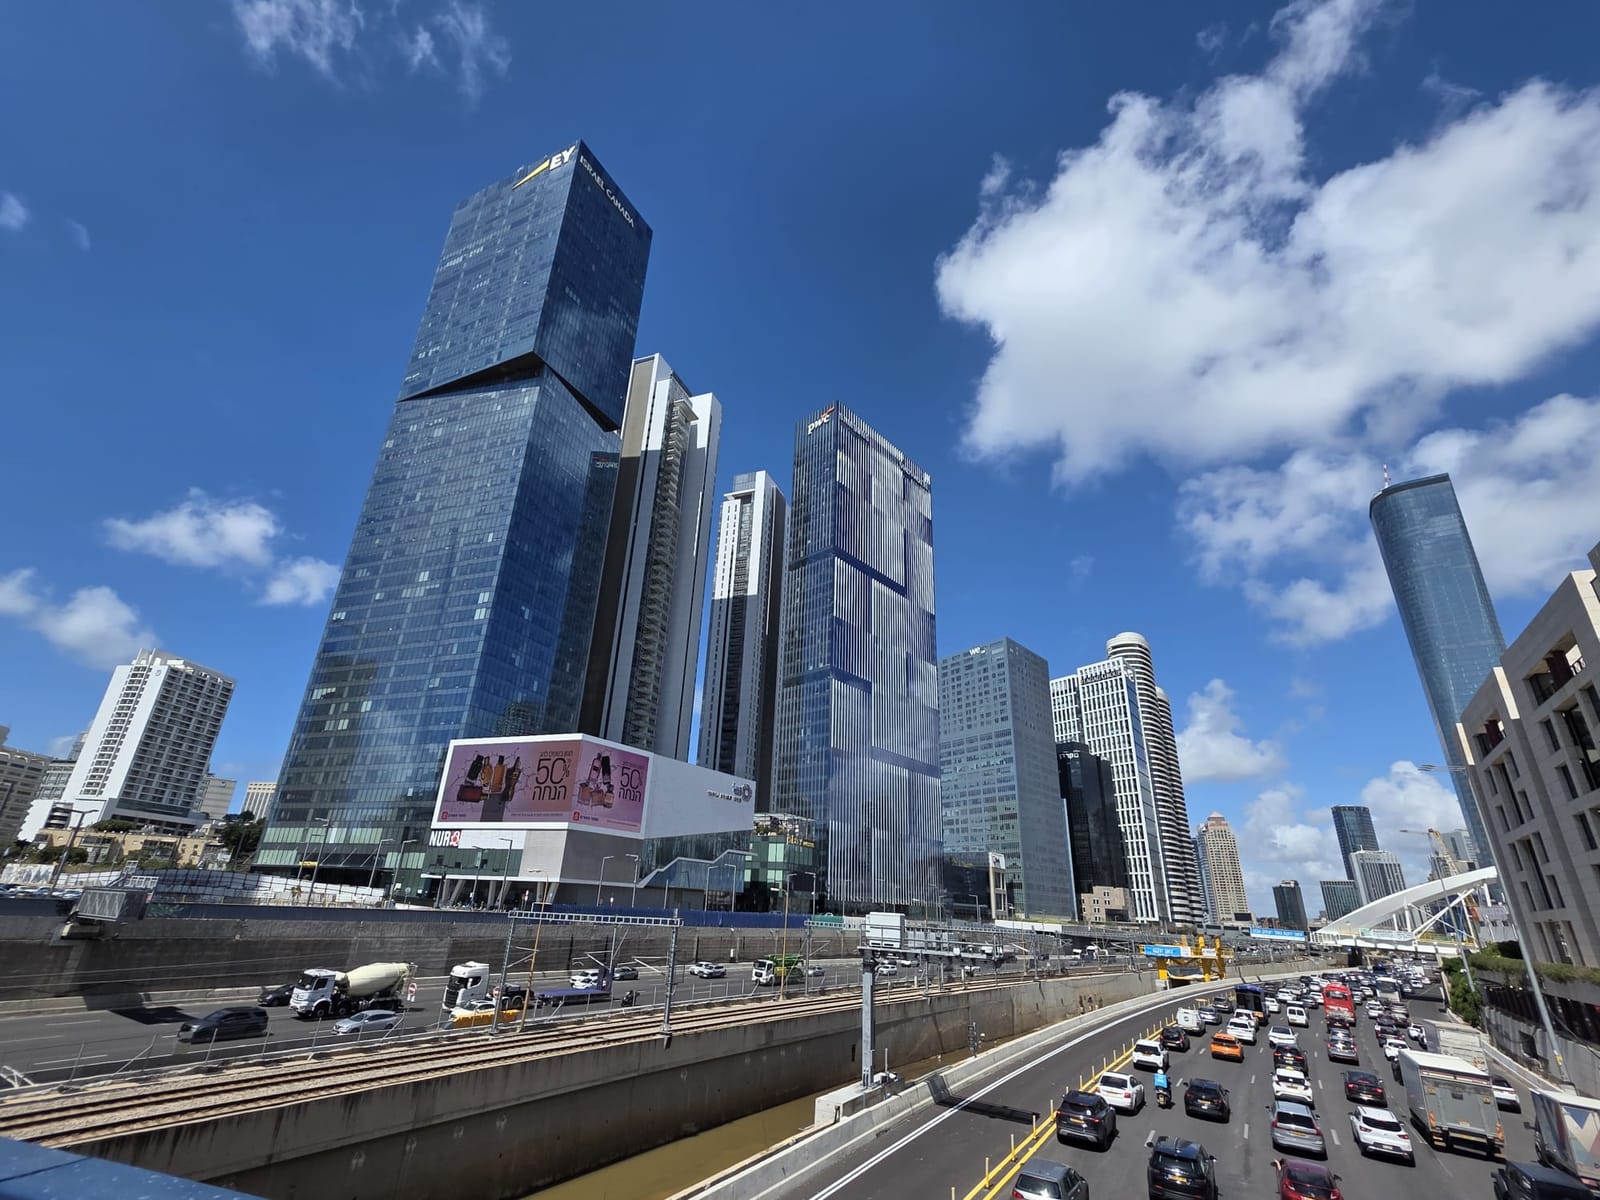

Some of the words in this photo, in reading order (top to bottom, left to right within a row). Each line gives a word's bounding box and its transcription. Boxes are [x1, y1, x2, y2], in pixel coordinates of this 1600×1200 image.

[549, 145, 576, 171] EY
[580, 155, 605, 191] ISRAEL
[605, 188, 635, 228] CANADA
[807, 415, 830, 436] pwc
[532, 785, 567, 801] הנחה
[618, 787, 642, 802] הנחה
